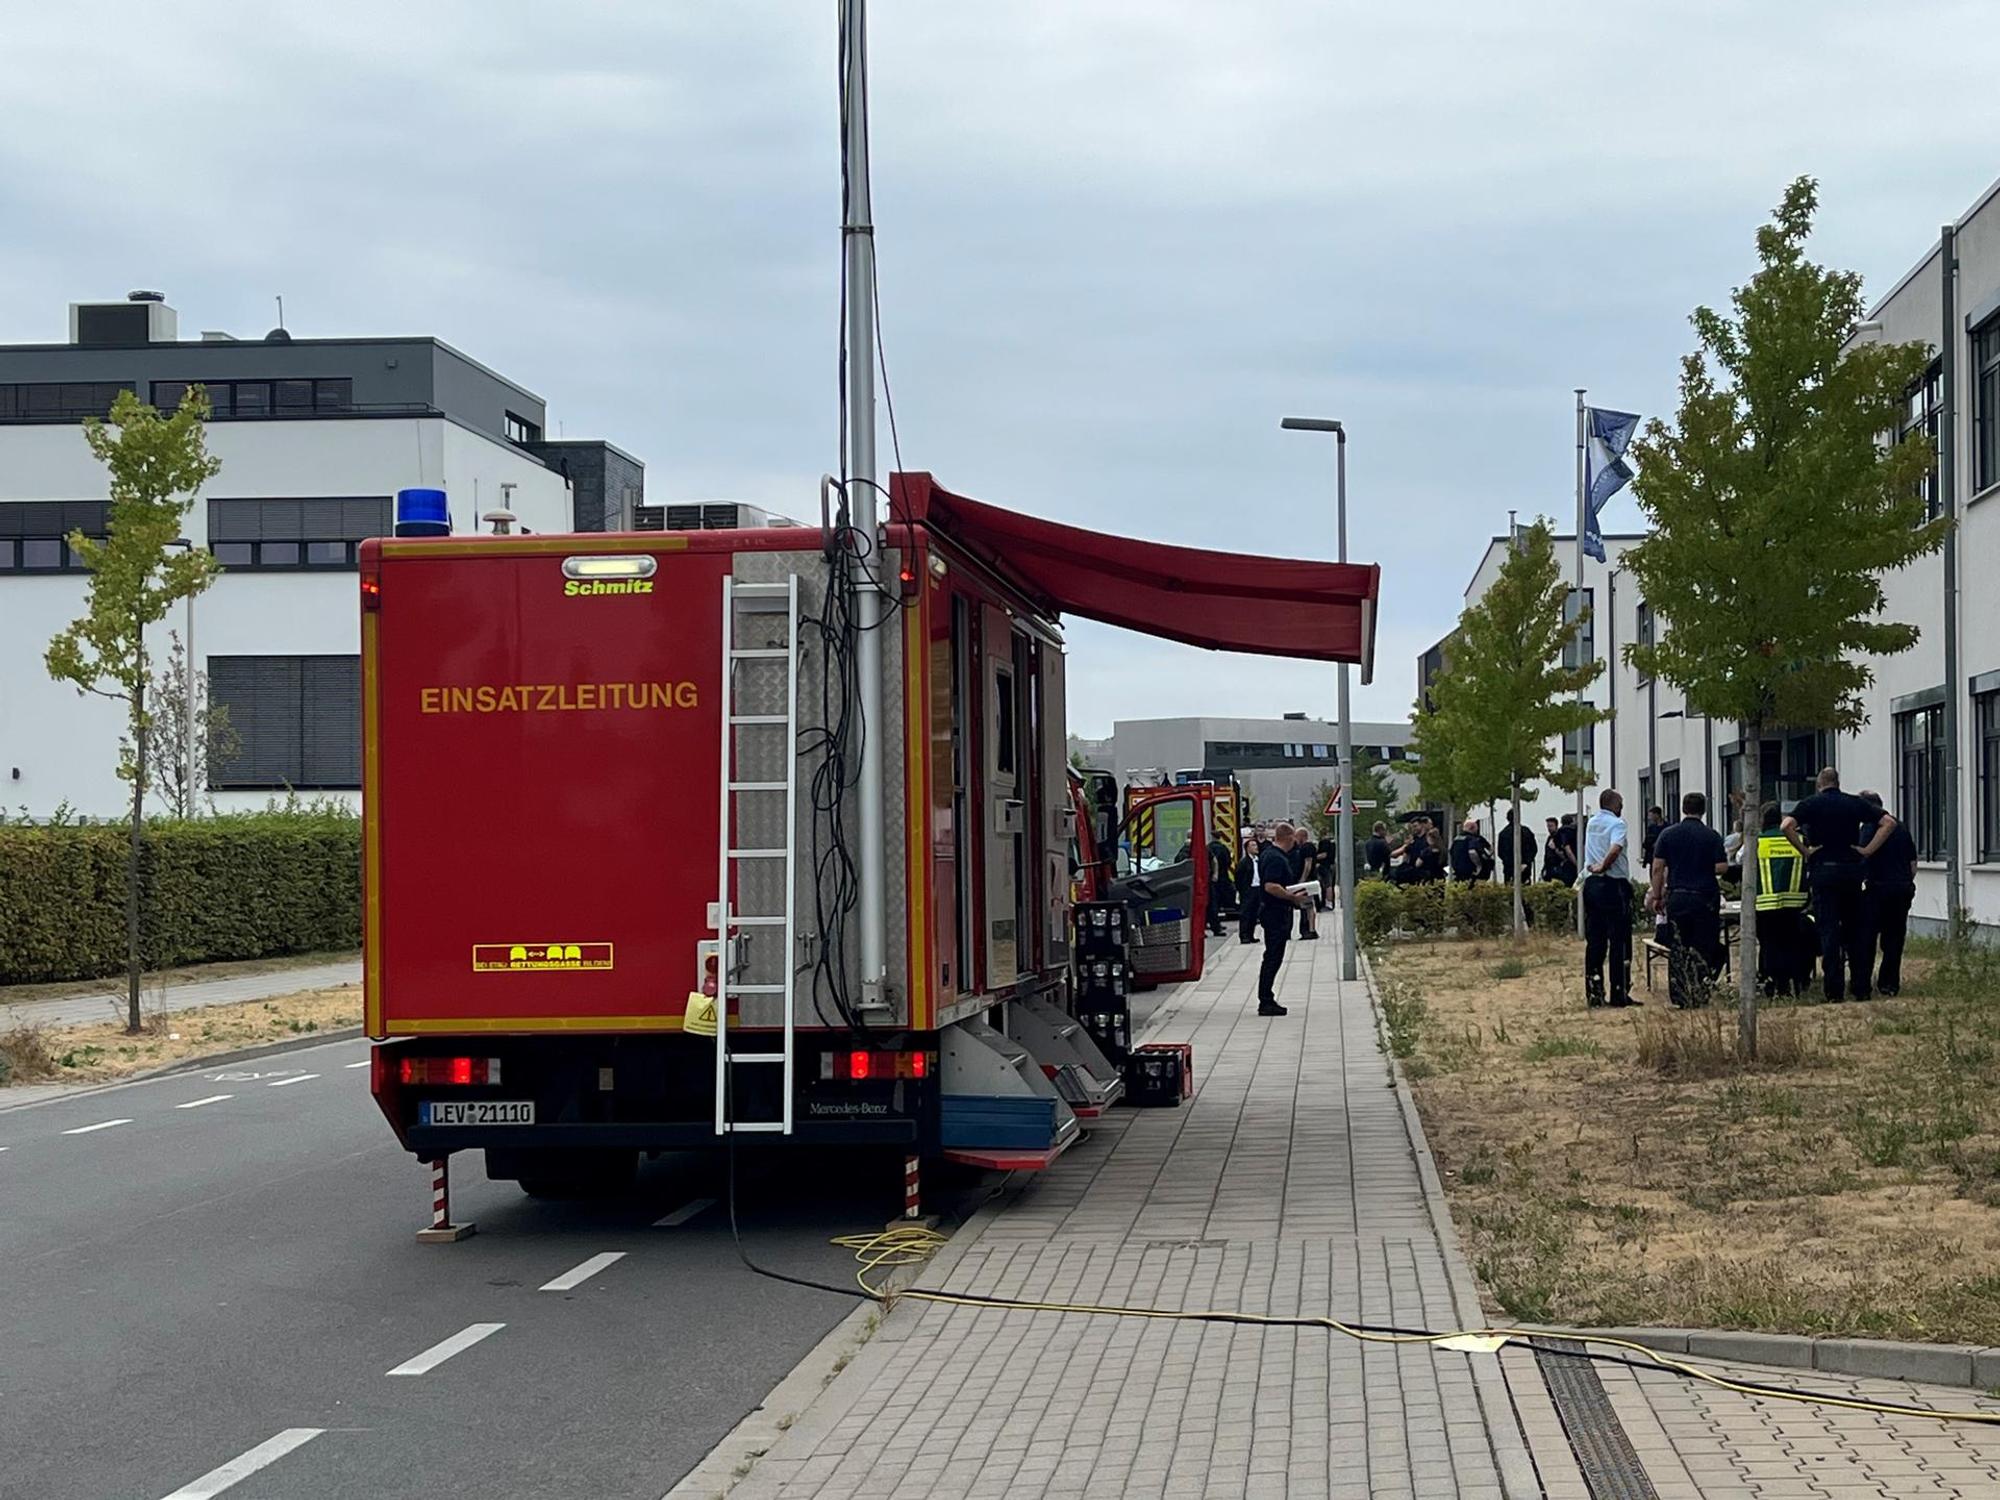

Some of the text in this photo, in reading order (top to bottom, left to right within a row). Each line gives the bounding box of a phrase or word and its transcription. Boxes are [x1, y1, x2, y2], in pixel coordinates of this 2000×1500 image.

[564, 579, 654, 596] Schmitz
[421, 682, 698, 713] EINSATZLEITUNG
[433, 1105, 465, 1123] LEV
[478, 1104, 531, 1123] 21110
